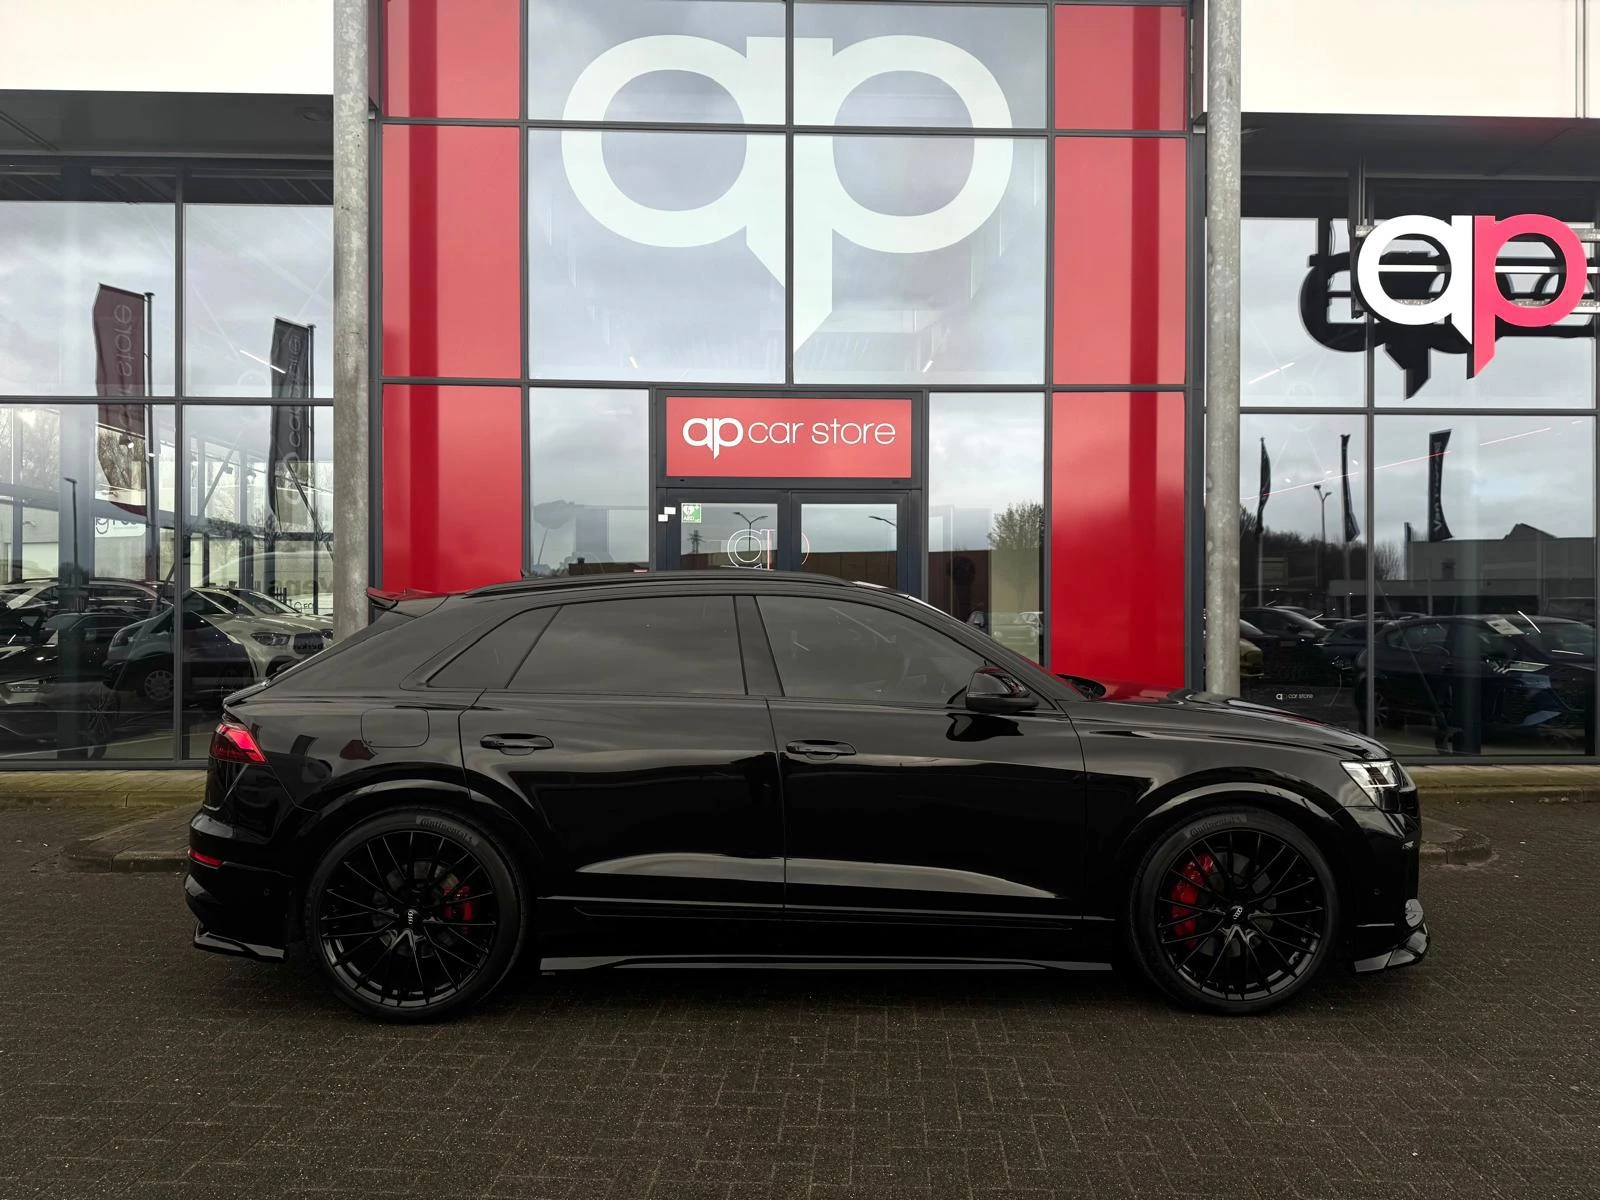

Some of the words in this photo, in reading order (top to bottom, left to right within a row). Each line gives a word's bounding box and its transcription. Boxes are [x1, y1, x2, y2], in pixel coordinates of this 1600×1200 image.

[561, 34, 1014, 353] ap
[1357, 213, 1588, 379] ap
[682, 417, 744, 460] ap
[748, 421, 804, 445] car
[811, 418, 896, 445] store
